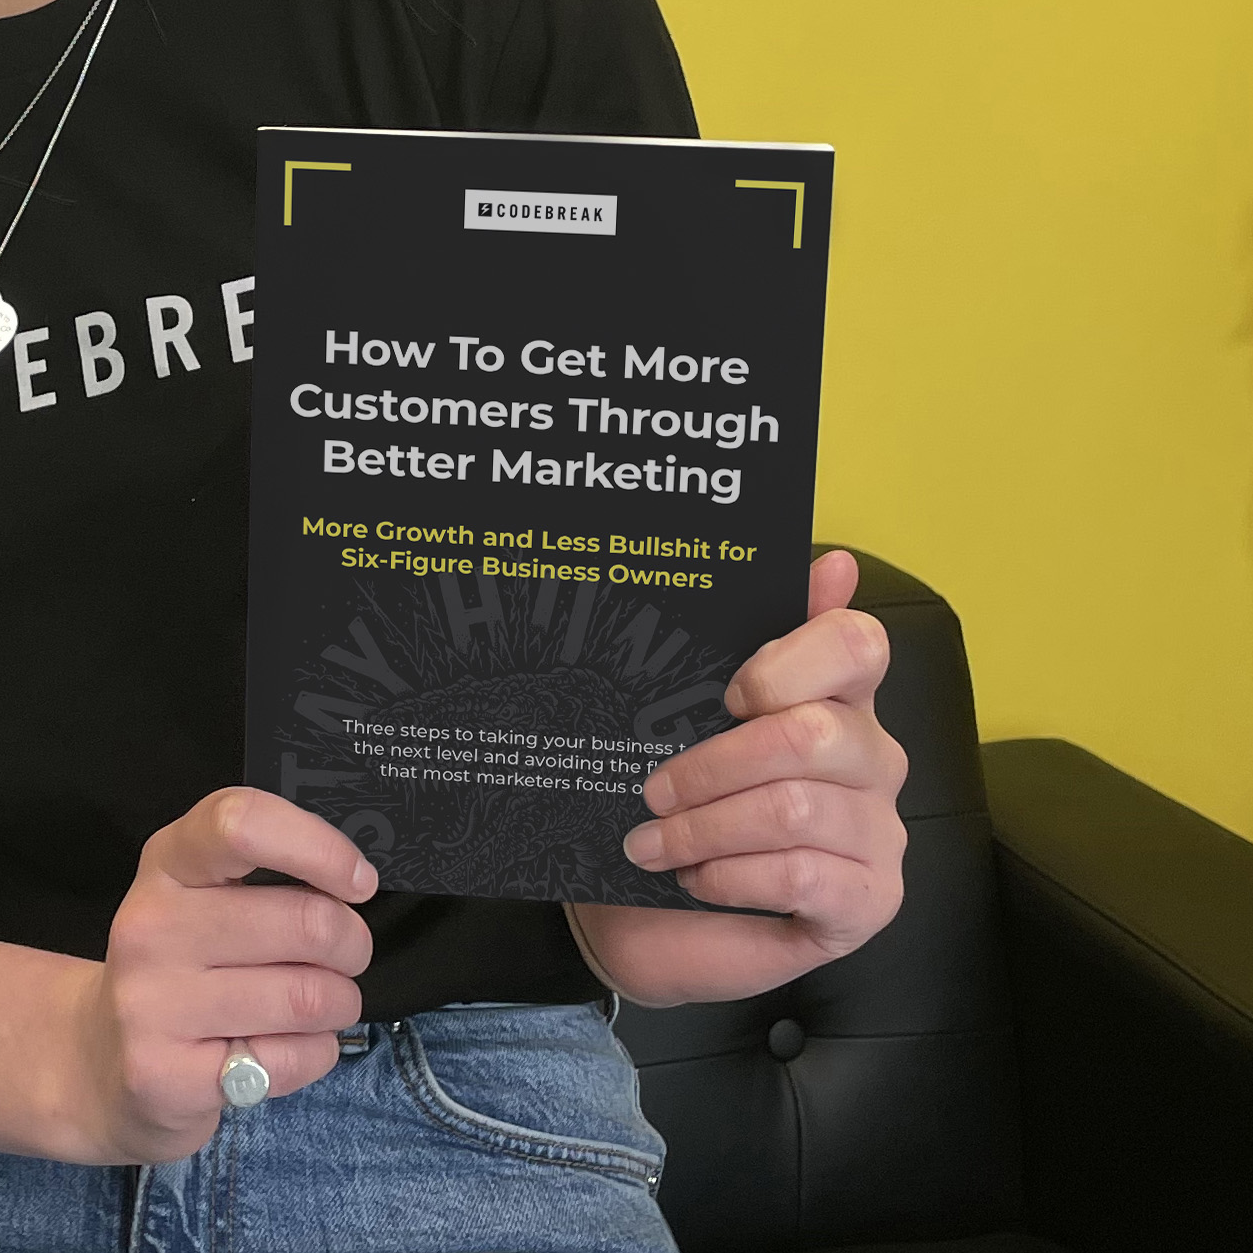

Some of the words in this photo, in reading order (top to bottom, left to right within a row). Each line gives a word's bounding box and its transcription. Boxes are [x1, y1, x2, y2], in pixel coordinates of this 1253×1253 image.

[496, 202, 604, 223] CODEBREAK
[326, 330, 436, 368] How
[449, 336, 504, 372] To
[521, 340, 606, 377] Get
[625, 345, 749, 384] More
[290, 384, 553, 429] Customers
[569, 398, 779, 449] Through
[324, 440, 475, 480] Better
[492, 449, 741, 504] Marketing
[303, 517, 368, 538] More
[376, 522, 473, 544] Growth
[483, 530, 532, 548] and
[543, 531, 600, 552] Less
[610, 535, 710, 559] Bullshit
[719, 541, 757, 561] for
[342, 548, 473, 576] Six-Figure
[483, 557, 600, 582] Business
[609, 565, 712, 588] Owners
[343, 720, 394, 735] Three
[401, 725, 449, 741] steps
[455, 728, 473, 740] to
[479, 730, 537, 748] taking
[543, 736, 585, 749] your
[592, 736, 673, 754] business
[354, 741, 384, 755] the
[391, 746, 430, 759] next
[438, 746, 477, 762] level
[484, 752, 518, 765] and
[525, 755, 603, 774] avoiding
[610, 758, 640, 773] the
[380, 764, 417, 778] that
[424, 769, 470, 782] most
[478, 773, 570, 789] marketers
[576, 777, 626, 793] focus
[632, 784, 643, 794] o
